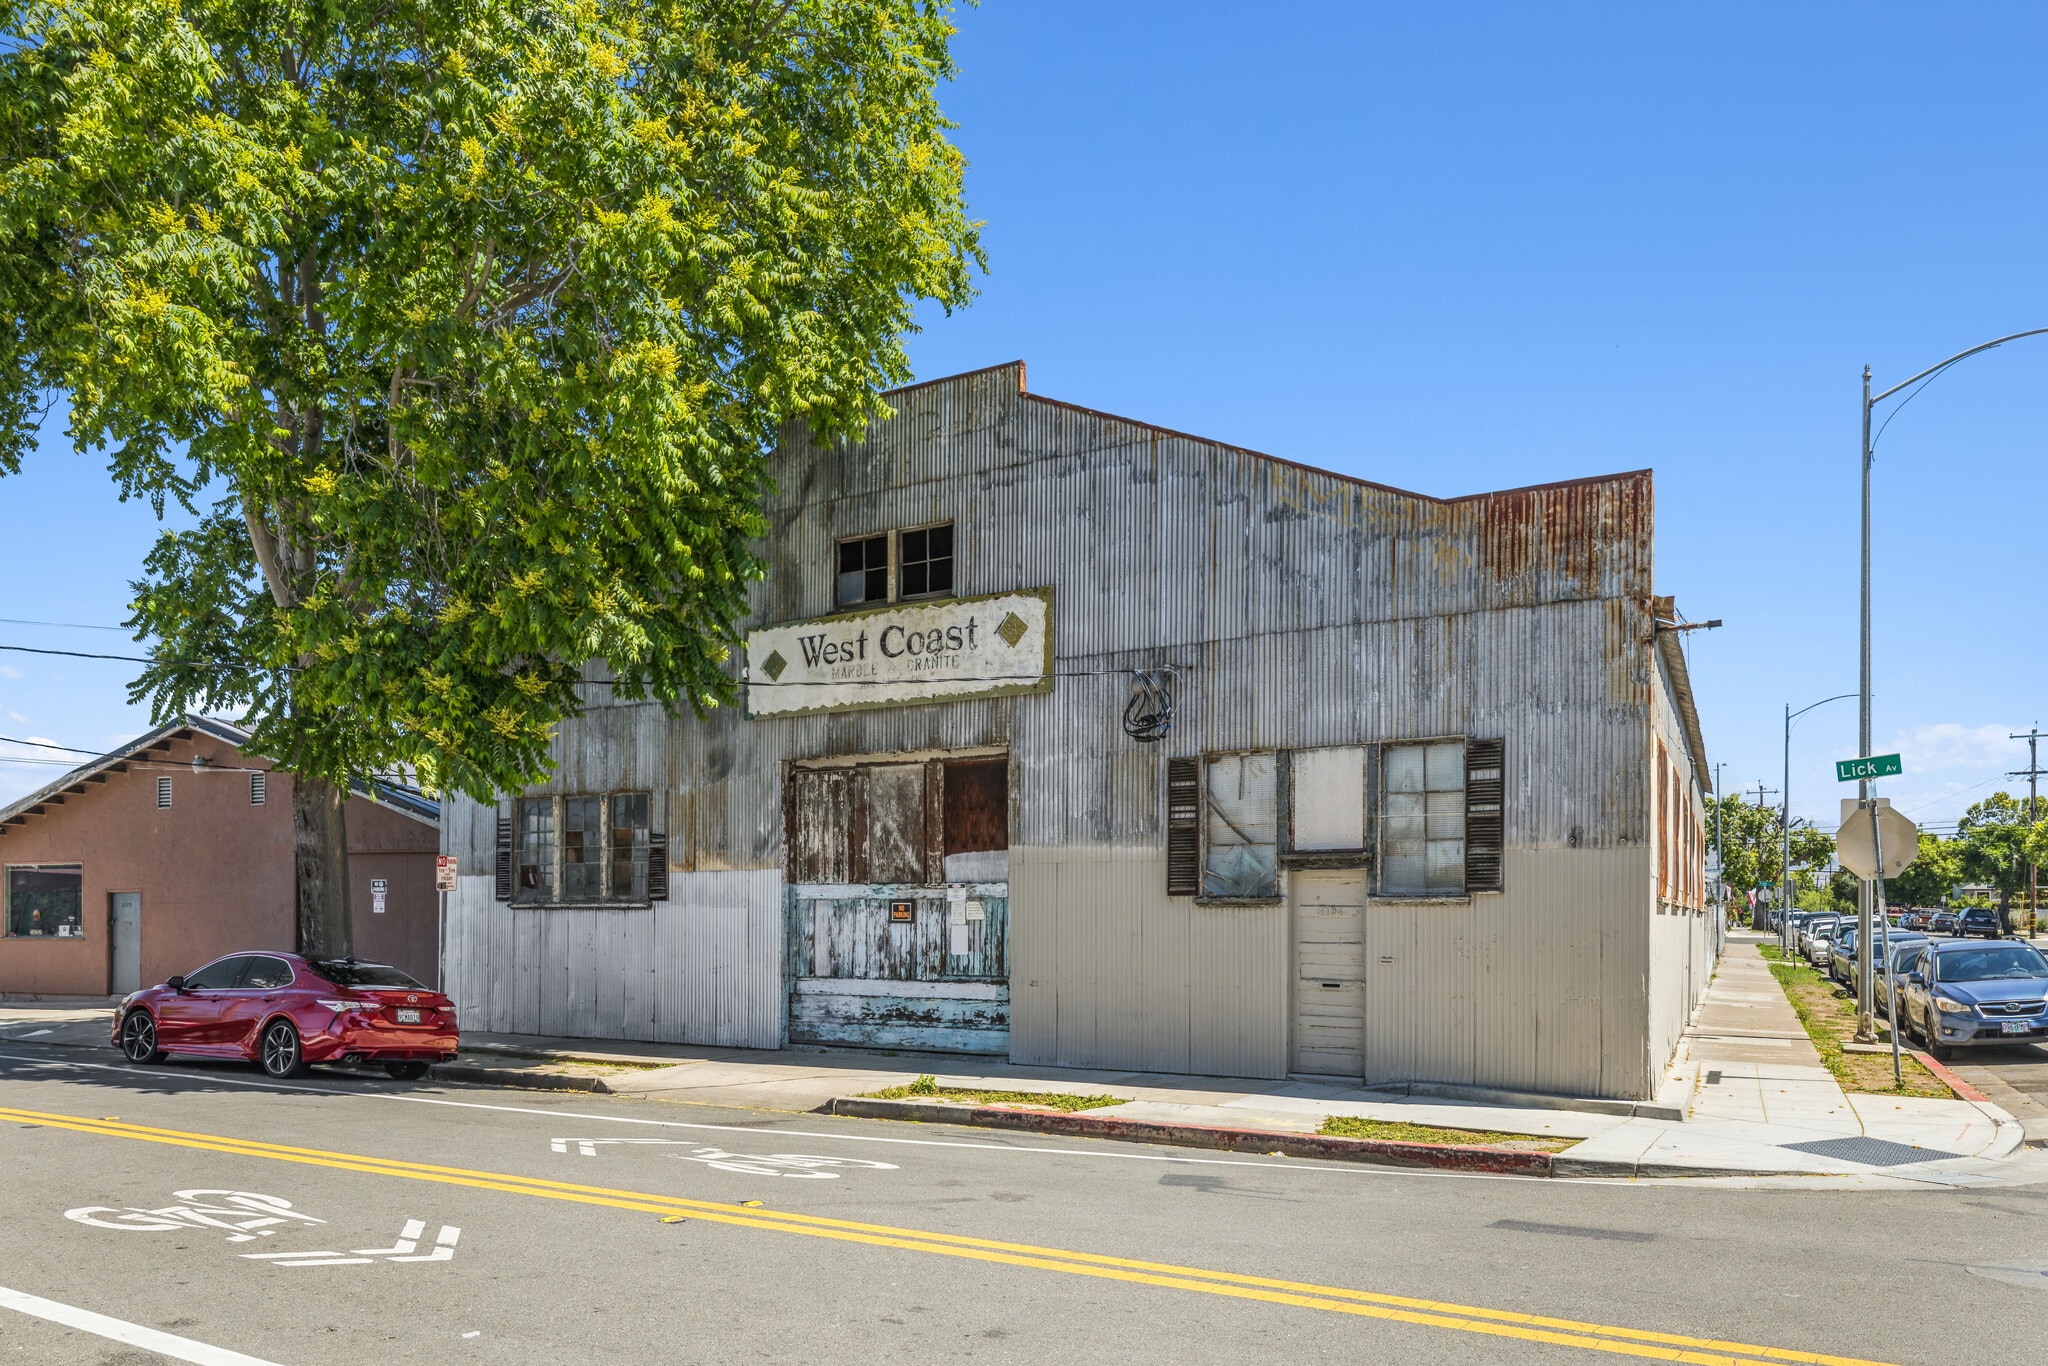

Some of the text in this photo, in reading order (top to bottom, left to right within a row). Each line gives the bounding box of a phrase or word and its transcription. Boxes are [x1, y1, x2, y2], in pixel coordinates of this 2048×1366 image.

[797, 615, 978, 670] West Coast
[906, 655, 961, 672] GRANITE
[1840, 761, 1897, 778] Lick Av
[438, 857, 446, 866] NO
